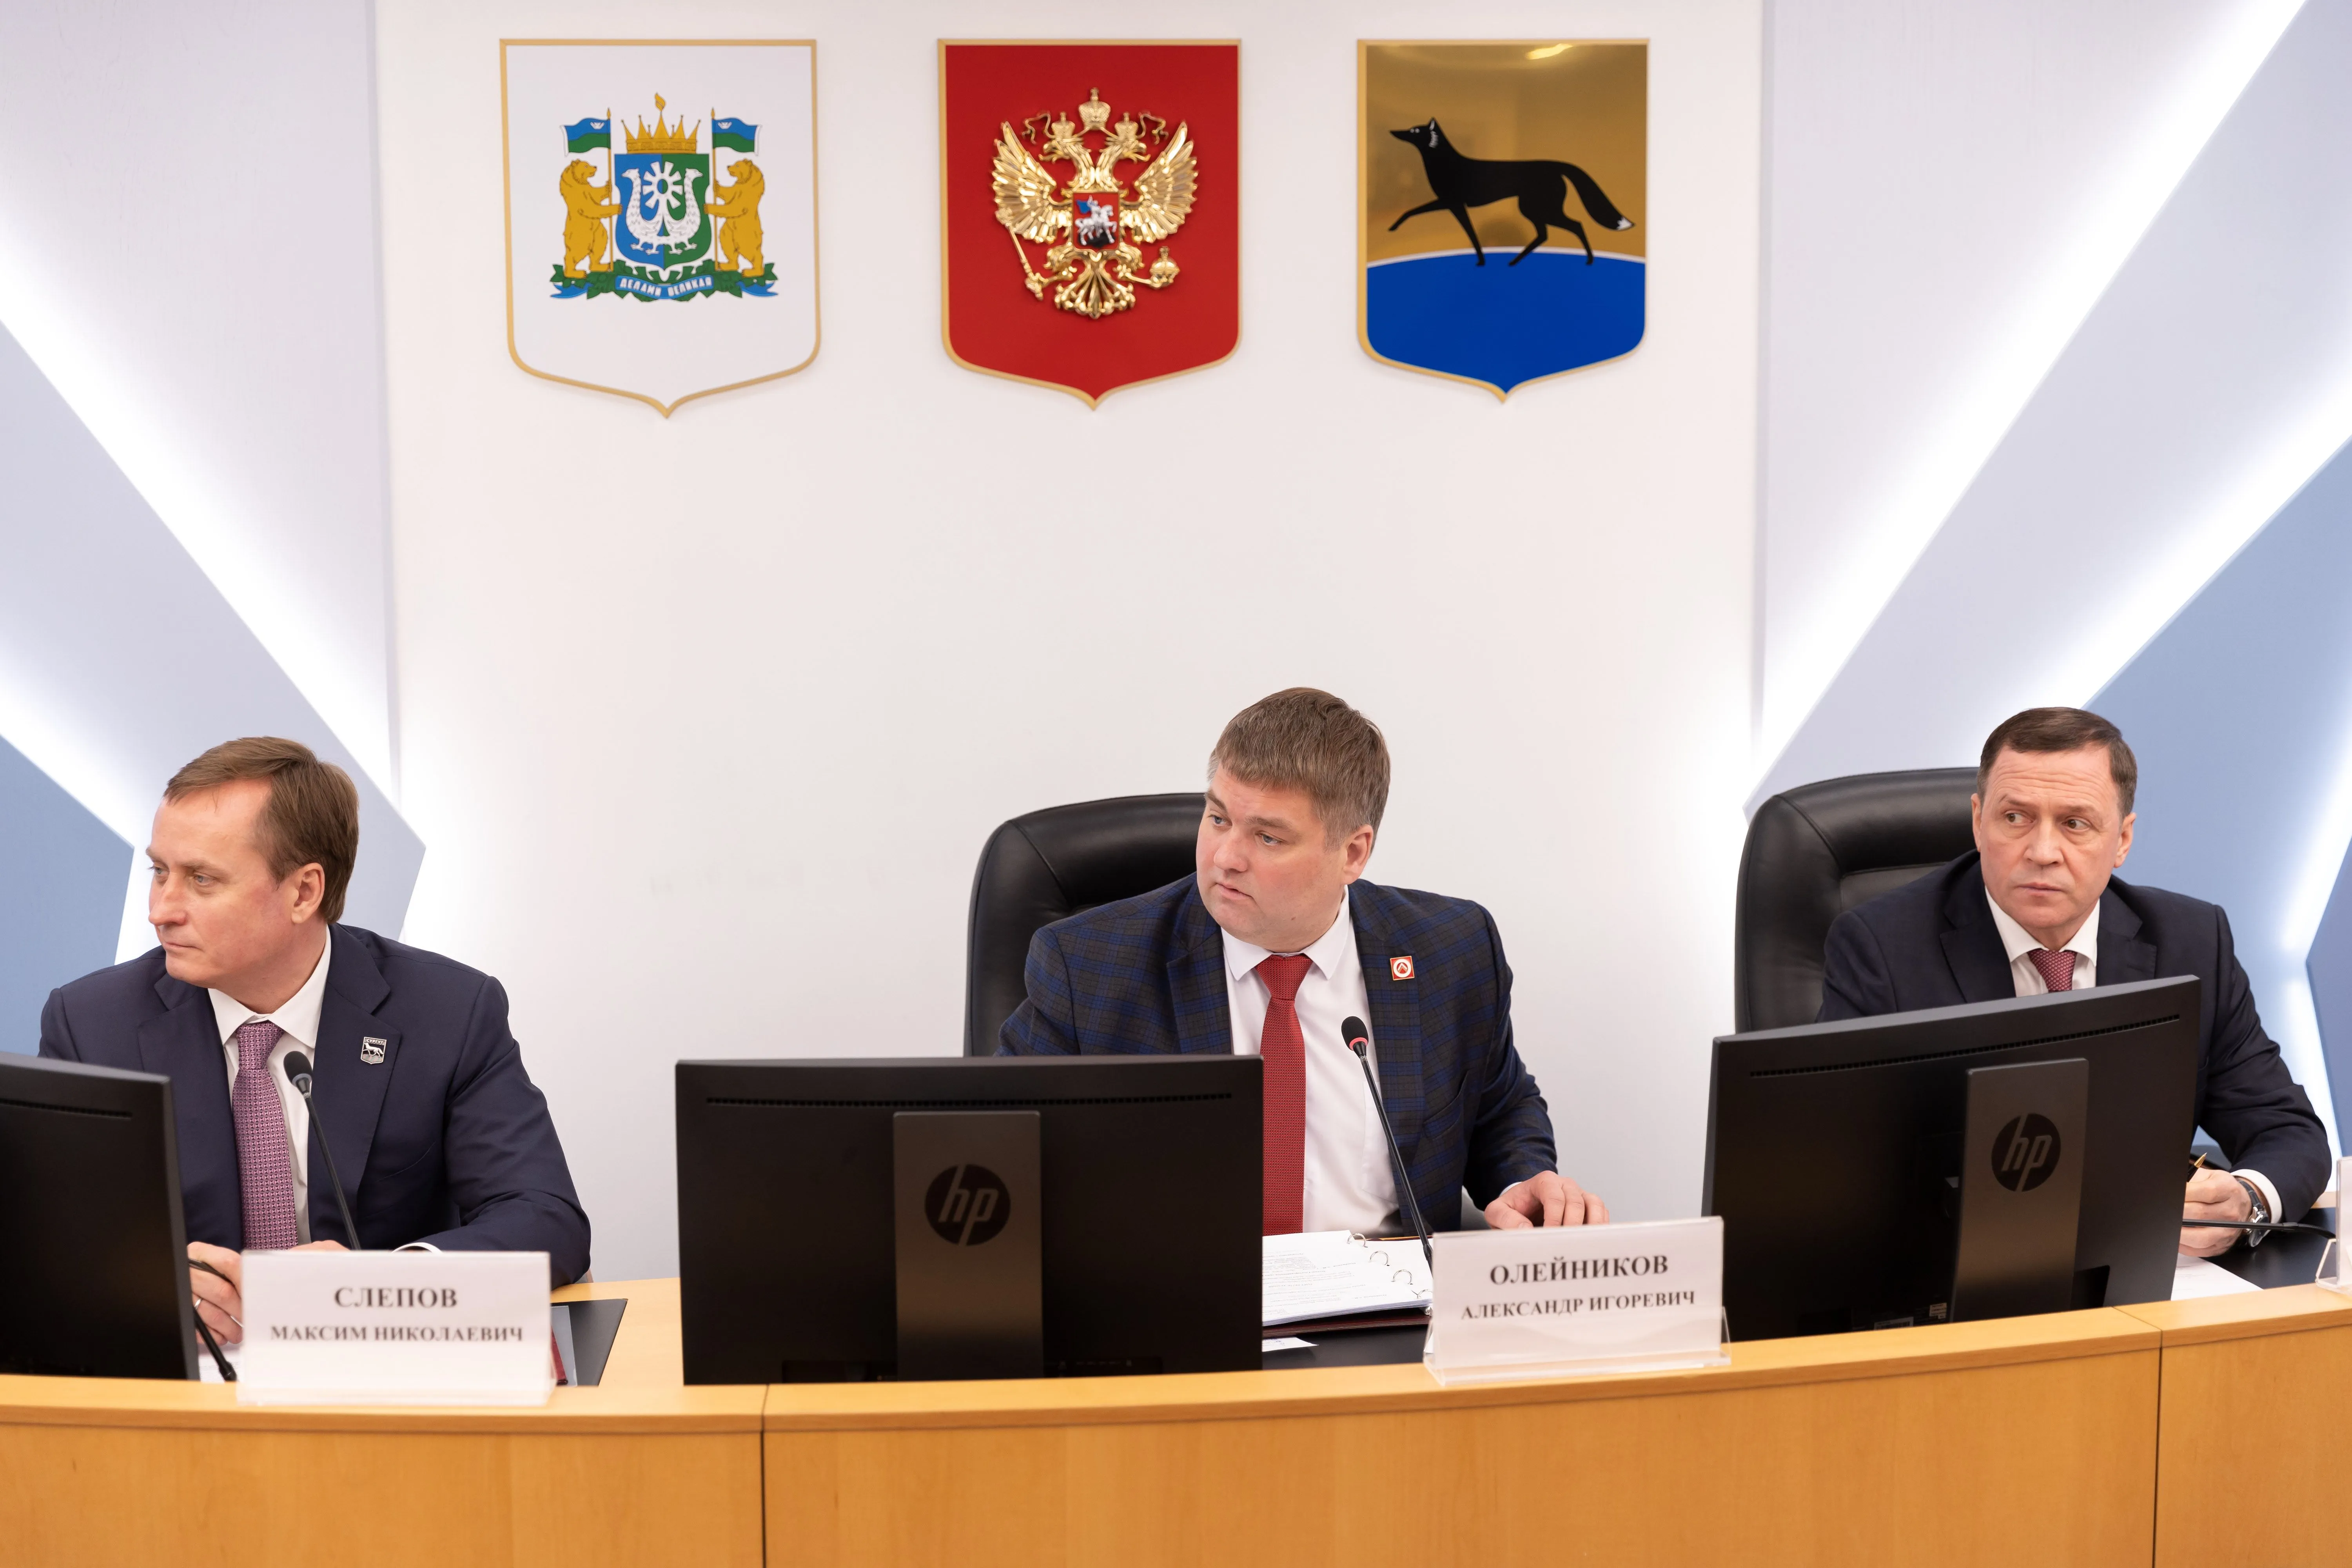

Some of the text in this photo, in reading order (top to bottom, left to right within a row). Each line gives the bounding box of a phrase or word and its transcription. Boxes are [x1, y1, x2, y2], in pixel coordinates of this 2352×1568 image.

[2001, 1113, 2053, 1192] hp
[938, 1163, 999, 1246] hp
[1489, 1254, 1669, 1285] ОЛЕЙНИКОВ
[334, 1287, 458, 1308] СЛЕПОВ
[1461, 1290, 1696, 1320] АЛЕКСАНДР ИГОРЕВИЧ
[270, 1325, 523, 1341] МАКСИМ НИКОЛАЕВИЧ
